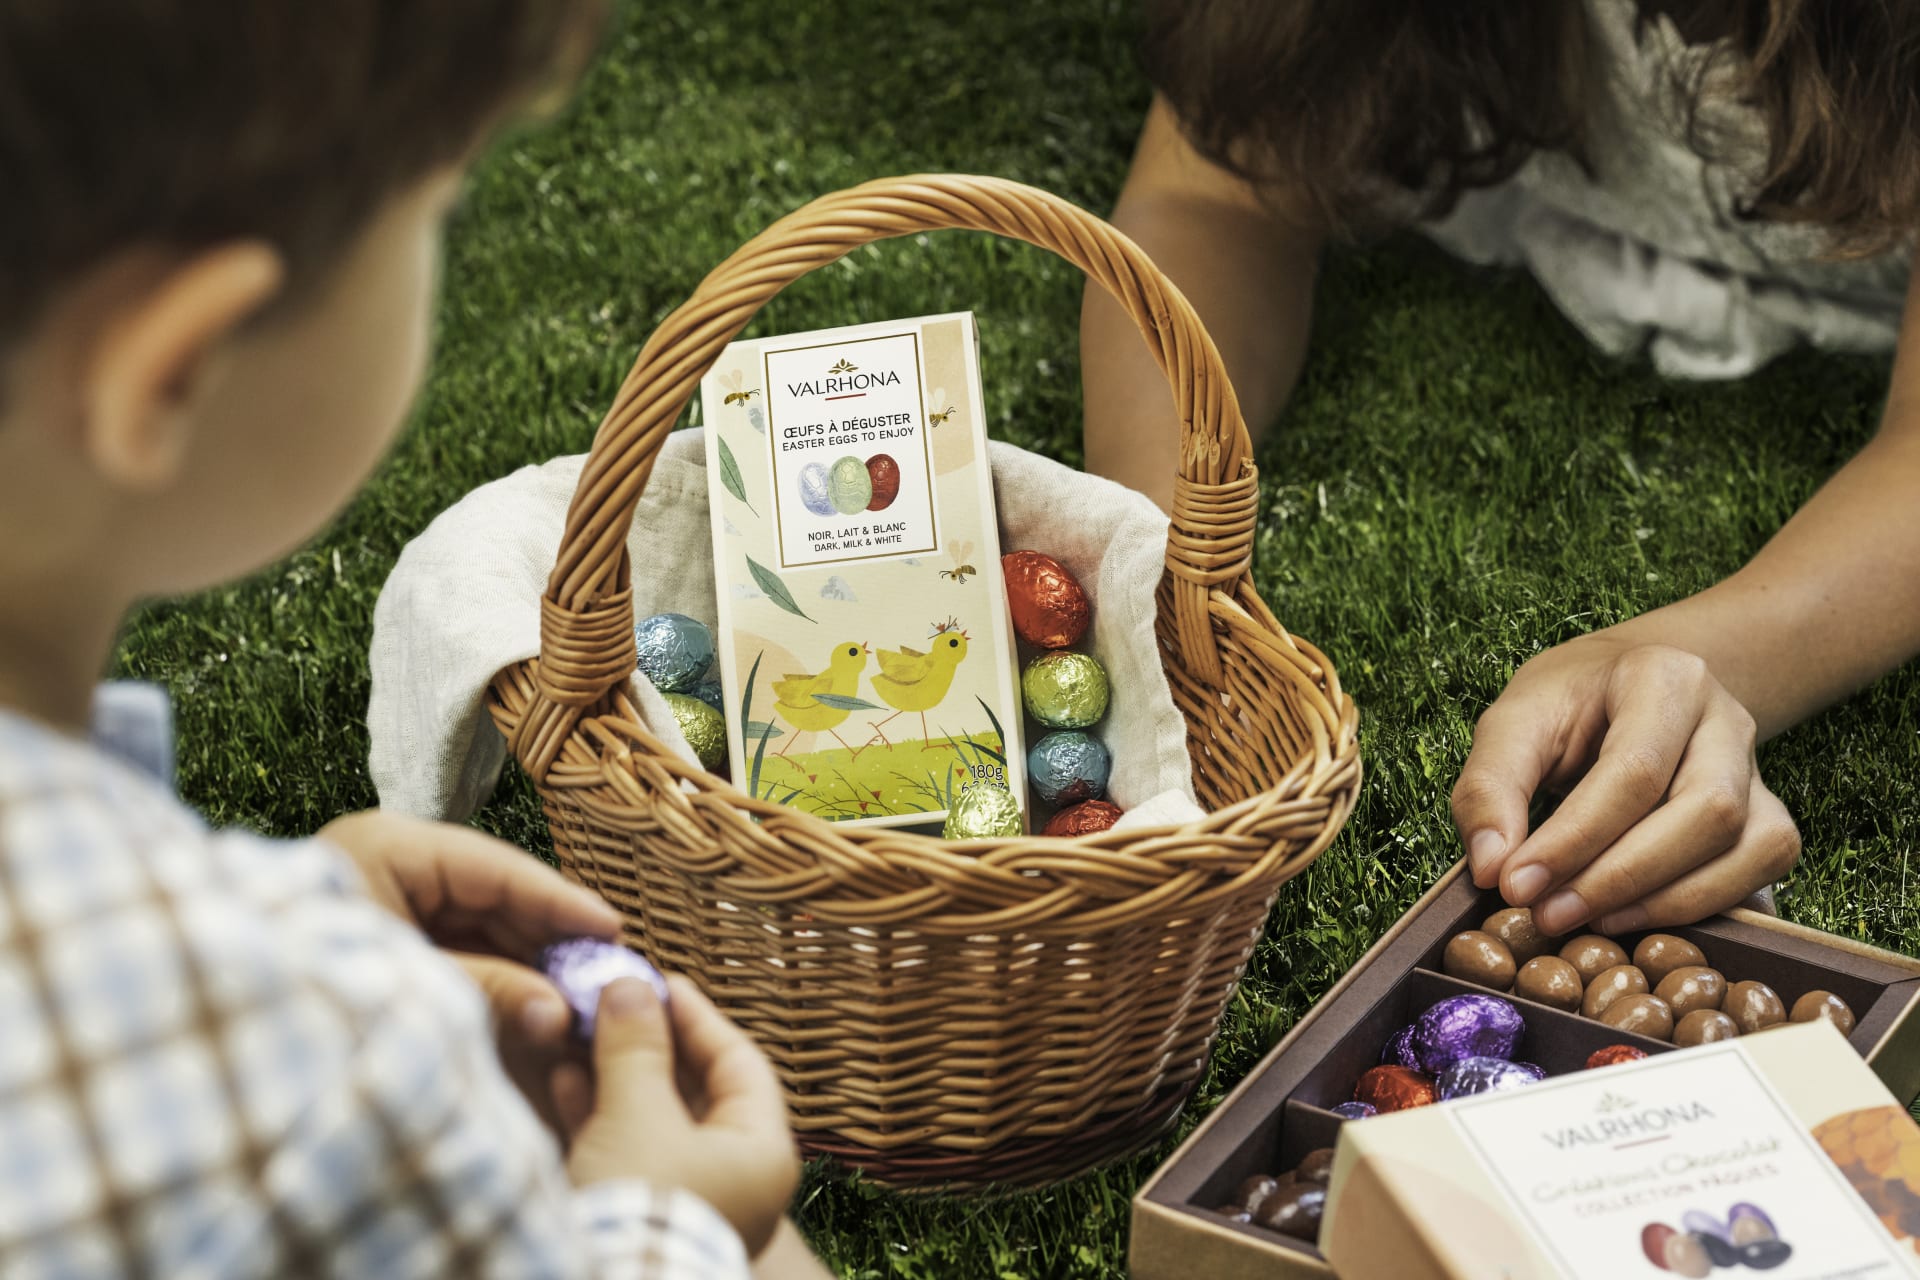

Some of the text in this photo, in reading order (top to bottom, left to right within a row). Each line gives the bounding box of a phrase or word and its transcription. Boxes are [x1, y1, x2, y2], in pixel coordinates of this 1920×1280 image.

[787, 370, 901, 398] VALRHONA
[783, 413, 912, 439] ŒUFS À DÉGUSTER
[782, 427, 915, 452] EASTER EGGS TO ENJOY
[837, 527, 860, 538] LAIT
[862, 526, 870, 535] &
[873, 522, 907, 534] BLANC
[843, 539, 864, 549] MILK
[865, 538, 872, 546] &
[875, 534, 903, 545] WHITE
[970, 763, 1004, 781] 180g
[1541, 1100, 1715, 1150] VALRHONA
[1573, 1183, 1696, 1218] COLLECTION
